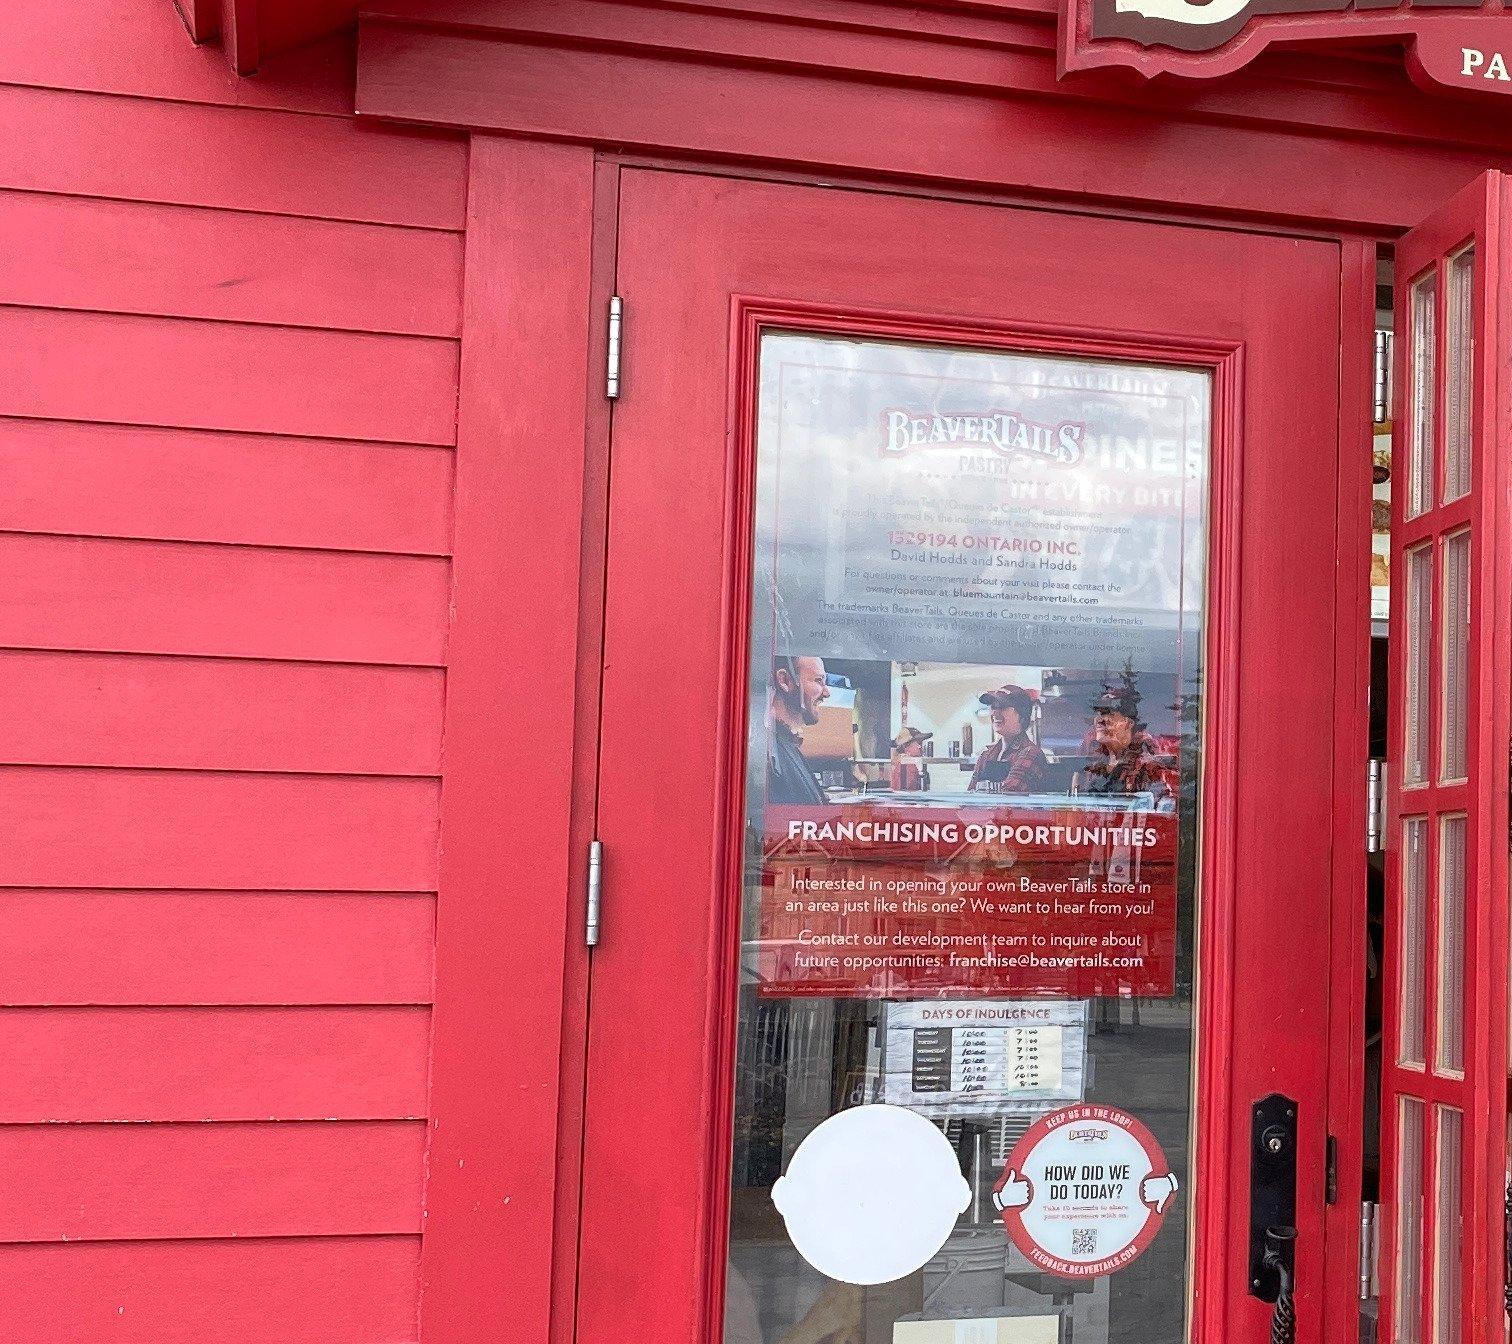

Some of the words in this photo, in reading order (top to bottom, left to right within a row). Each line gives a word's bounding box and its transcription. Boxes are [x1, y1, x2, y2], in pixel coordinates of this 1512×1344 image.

[962, 534, 1042, 554] ONTARIO
[1046, 539, 1082, 555] INC.
[890, 548, 926, 562] David
[929, 550, 967, 565] Hodds
[970, 552, 993, 566] and
[995, 554, 1036, 569] Sandra
[1039, 558, 1078, 572] Hodds
[844, 567, 860, 579] For
[862, 570, 907, 583] questions
[909, 573, 920, 582] or
[920, 573, 968, 585] comments
[971, 575, 997, 587] about
[999, 578, 1021, 591] your
[1042, 578, 1070, 593] please
[1072, 580, 1104, 593] contact
[1107, 582, 1122, 593] the
[985, 609, 998, 619] de
[787, 819, 958, 845] FRANCHISING
[963, 823, 1157, 848] OPPORTUNITIES
[790, 874, 865, 892] Interested
[868, 876, 883, 891] in
[886, 878, 946, 897] opening
[949, 881, 982, 897] your
[985, 881, 1017, 894] own
[1020, 877, 1097, 895] BeaverTails
[1100, 879, 1137, 895] store
[1138, 880, 1151, 894] in
[784, 901, 804, 913] an
[806, 901, 840, 914] area
[842, 899, 871, 917] just
[873, 898, 899, 914] like
[901, 899, 928, 914] this
[930, 899, 965, 915] one?
[969, 899, 996, 915] We
[997, 900, 1032, 916] want
[1034, 901, 1052, 915] to
[1053, 900, 1086, 915] hear
[1088, 900, 1122, 916] from
[1124, 900, 1156, 918] you!
[798, 929, 860, 946] Contact
[862, 933, 888, 947] our
[891, 930, 988, 950] development
[991, 933, 1029, 948] team
[1031, 933, 1048, 947] to
[1049, 931, 1099, 950] inquire
[1101, 931, 1142, 948] about
[794, 951, 840, 968] future
[842, 952, 946, 970] opportunities:
[948, 951, 1144, 970] franchise@beavertails.com
[922, 1009, 953, 1021] DAYS
[955, 1009, 971, 1020] OF
[974, 1008, 1052, 1020] INDULGENCE
[1045, 1113, 1066, 1130] KEEP
[1093, 1107, 1108, 1119] THE
[1044, 1165, 1077, 1182] HOW
[1081, 1165, 1104, 1181] DID
[1108, 1164, 1131, 1181] WE
[1050, 1184, 1068, 1201] DO
[1073, 1183, 1124, 1200] TODAY?
